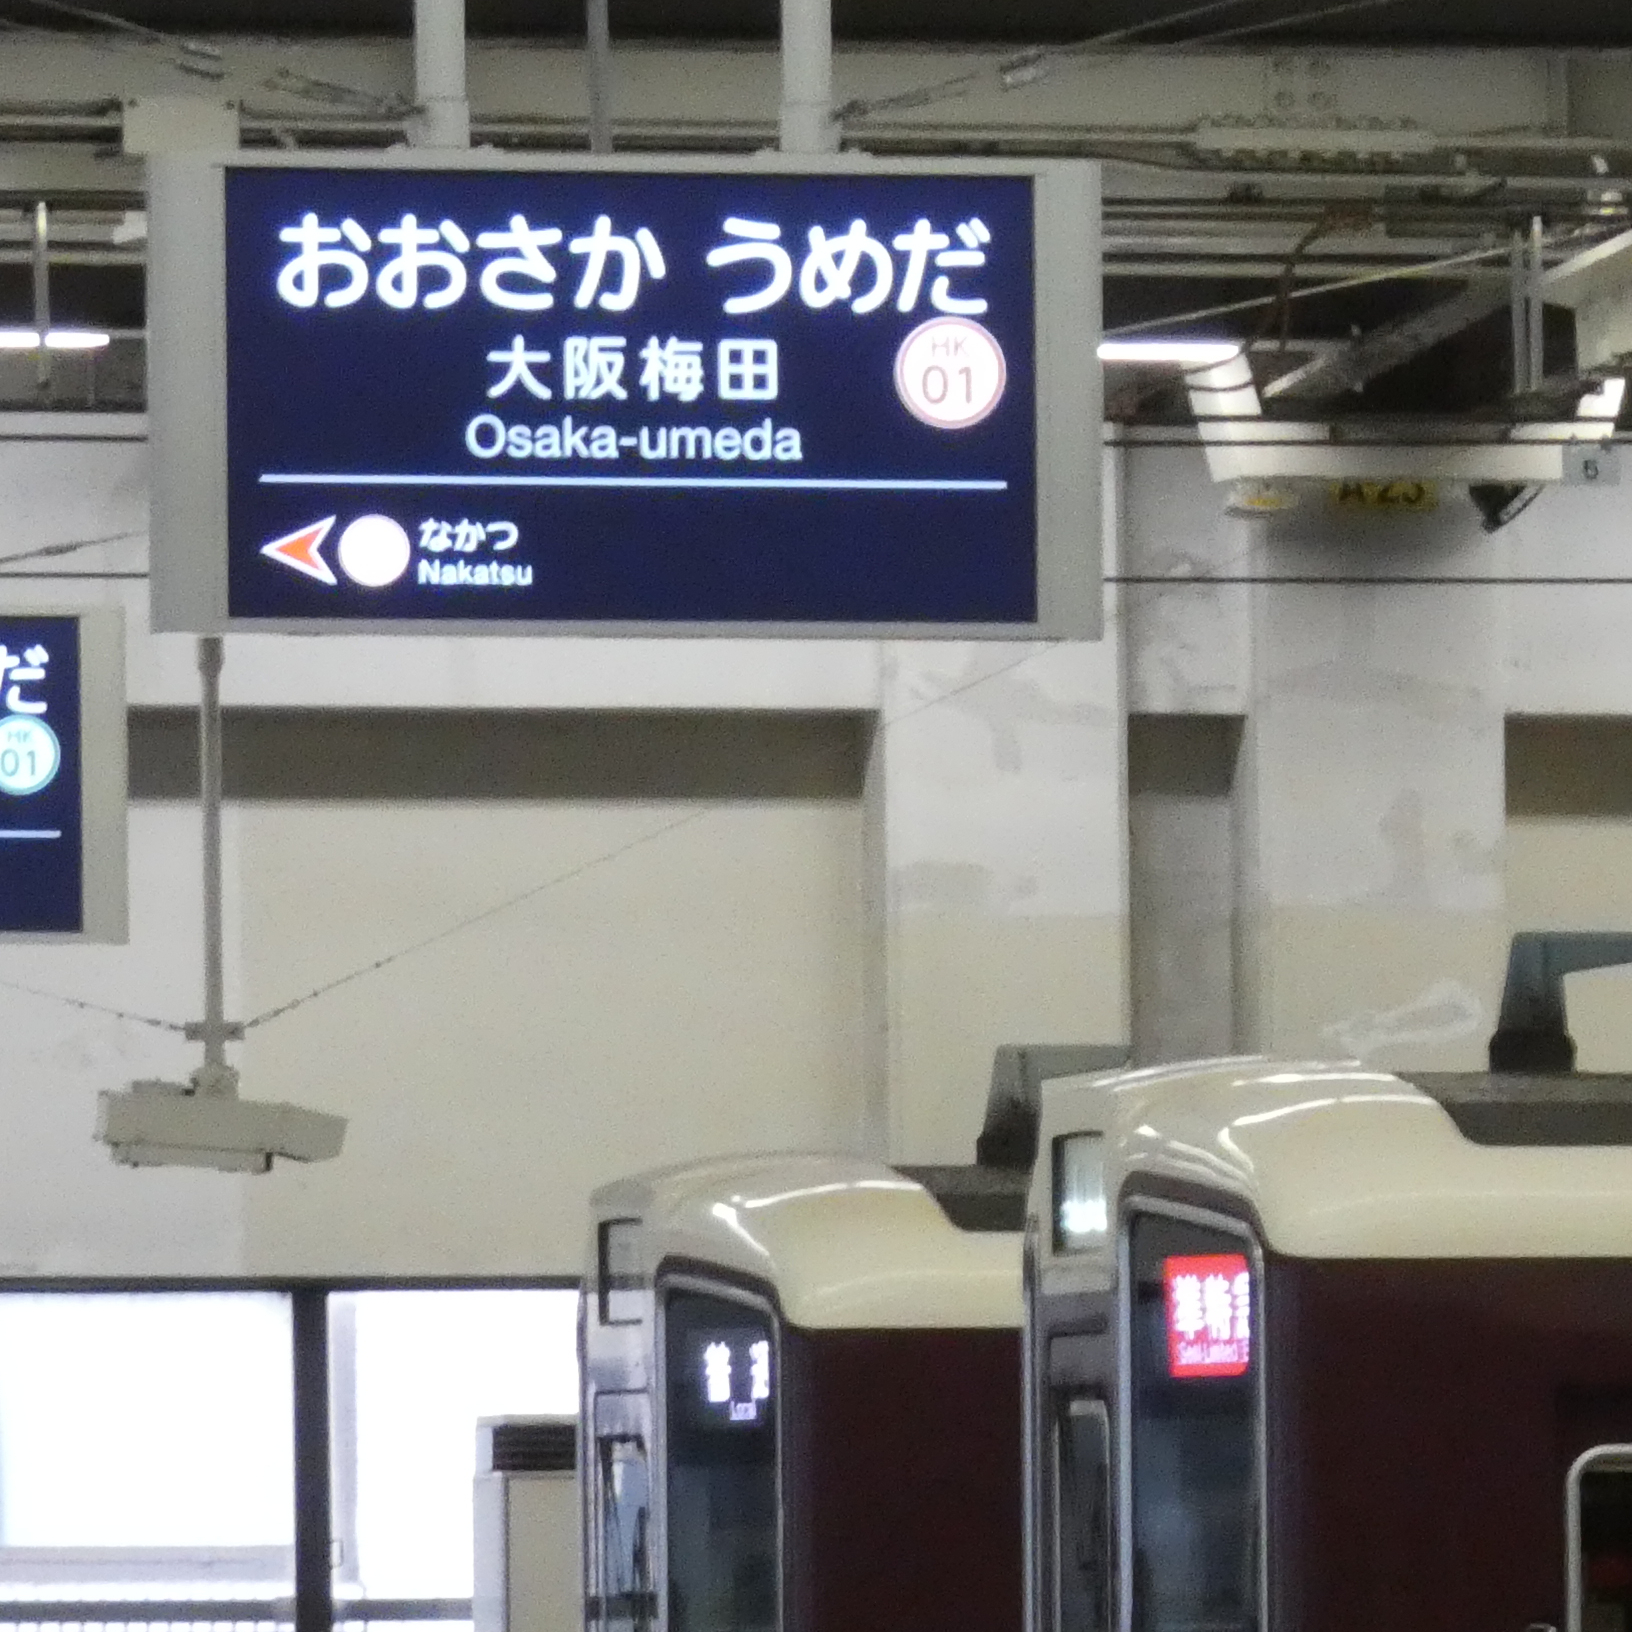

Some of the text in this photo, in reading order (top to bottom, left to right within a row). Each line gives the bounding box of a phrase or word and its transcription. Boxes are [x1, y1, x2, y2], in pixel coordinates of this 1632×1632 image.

[276, 212, 992, 315] おおさか うめだ
[931, 336, 970, 357] HK
[486, 334, 780, 402] 大阪梅田
[922, 364, 972, 405] 01
[465, 413, 803, 462] Osaka-umeda
[418, 517, 519, 553] なかつ
[417, 558, 533, 587] Nakatsu
[0, 643, 50, 715] だ
[1, 748, 37, 778] 01
